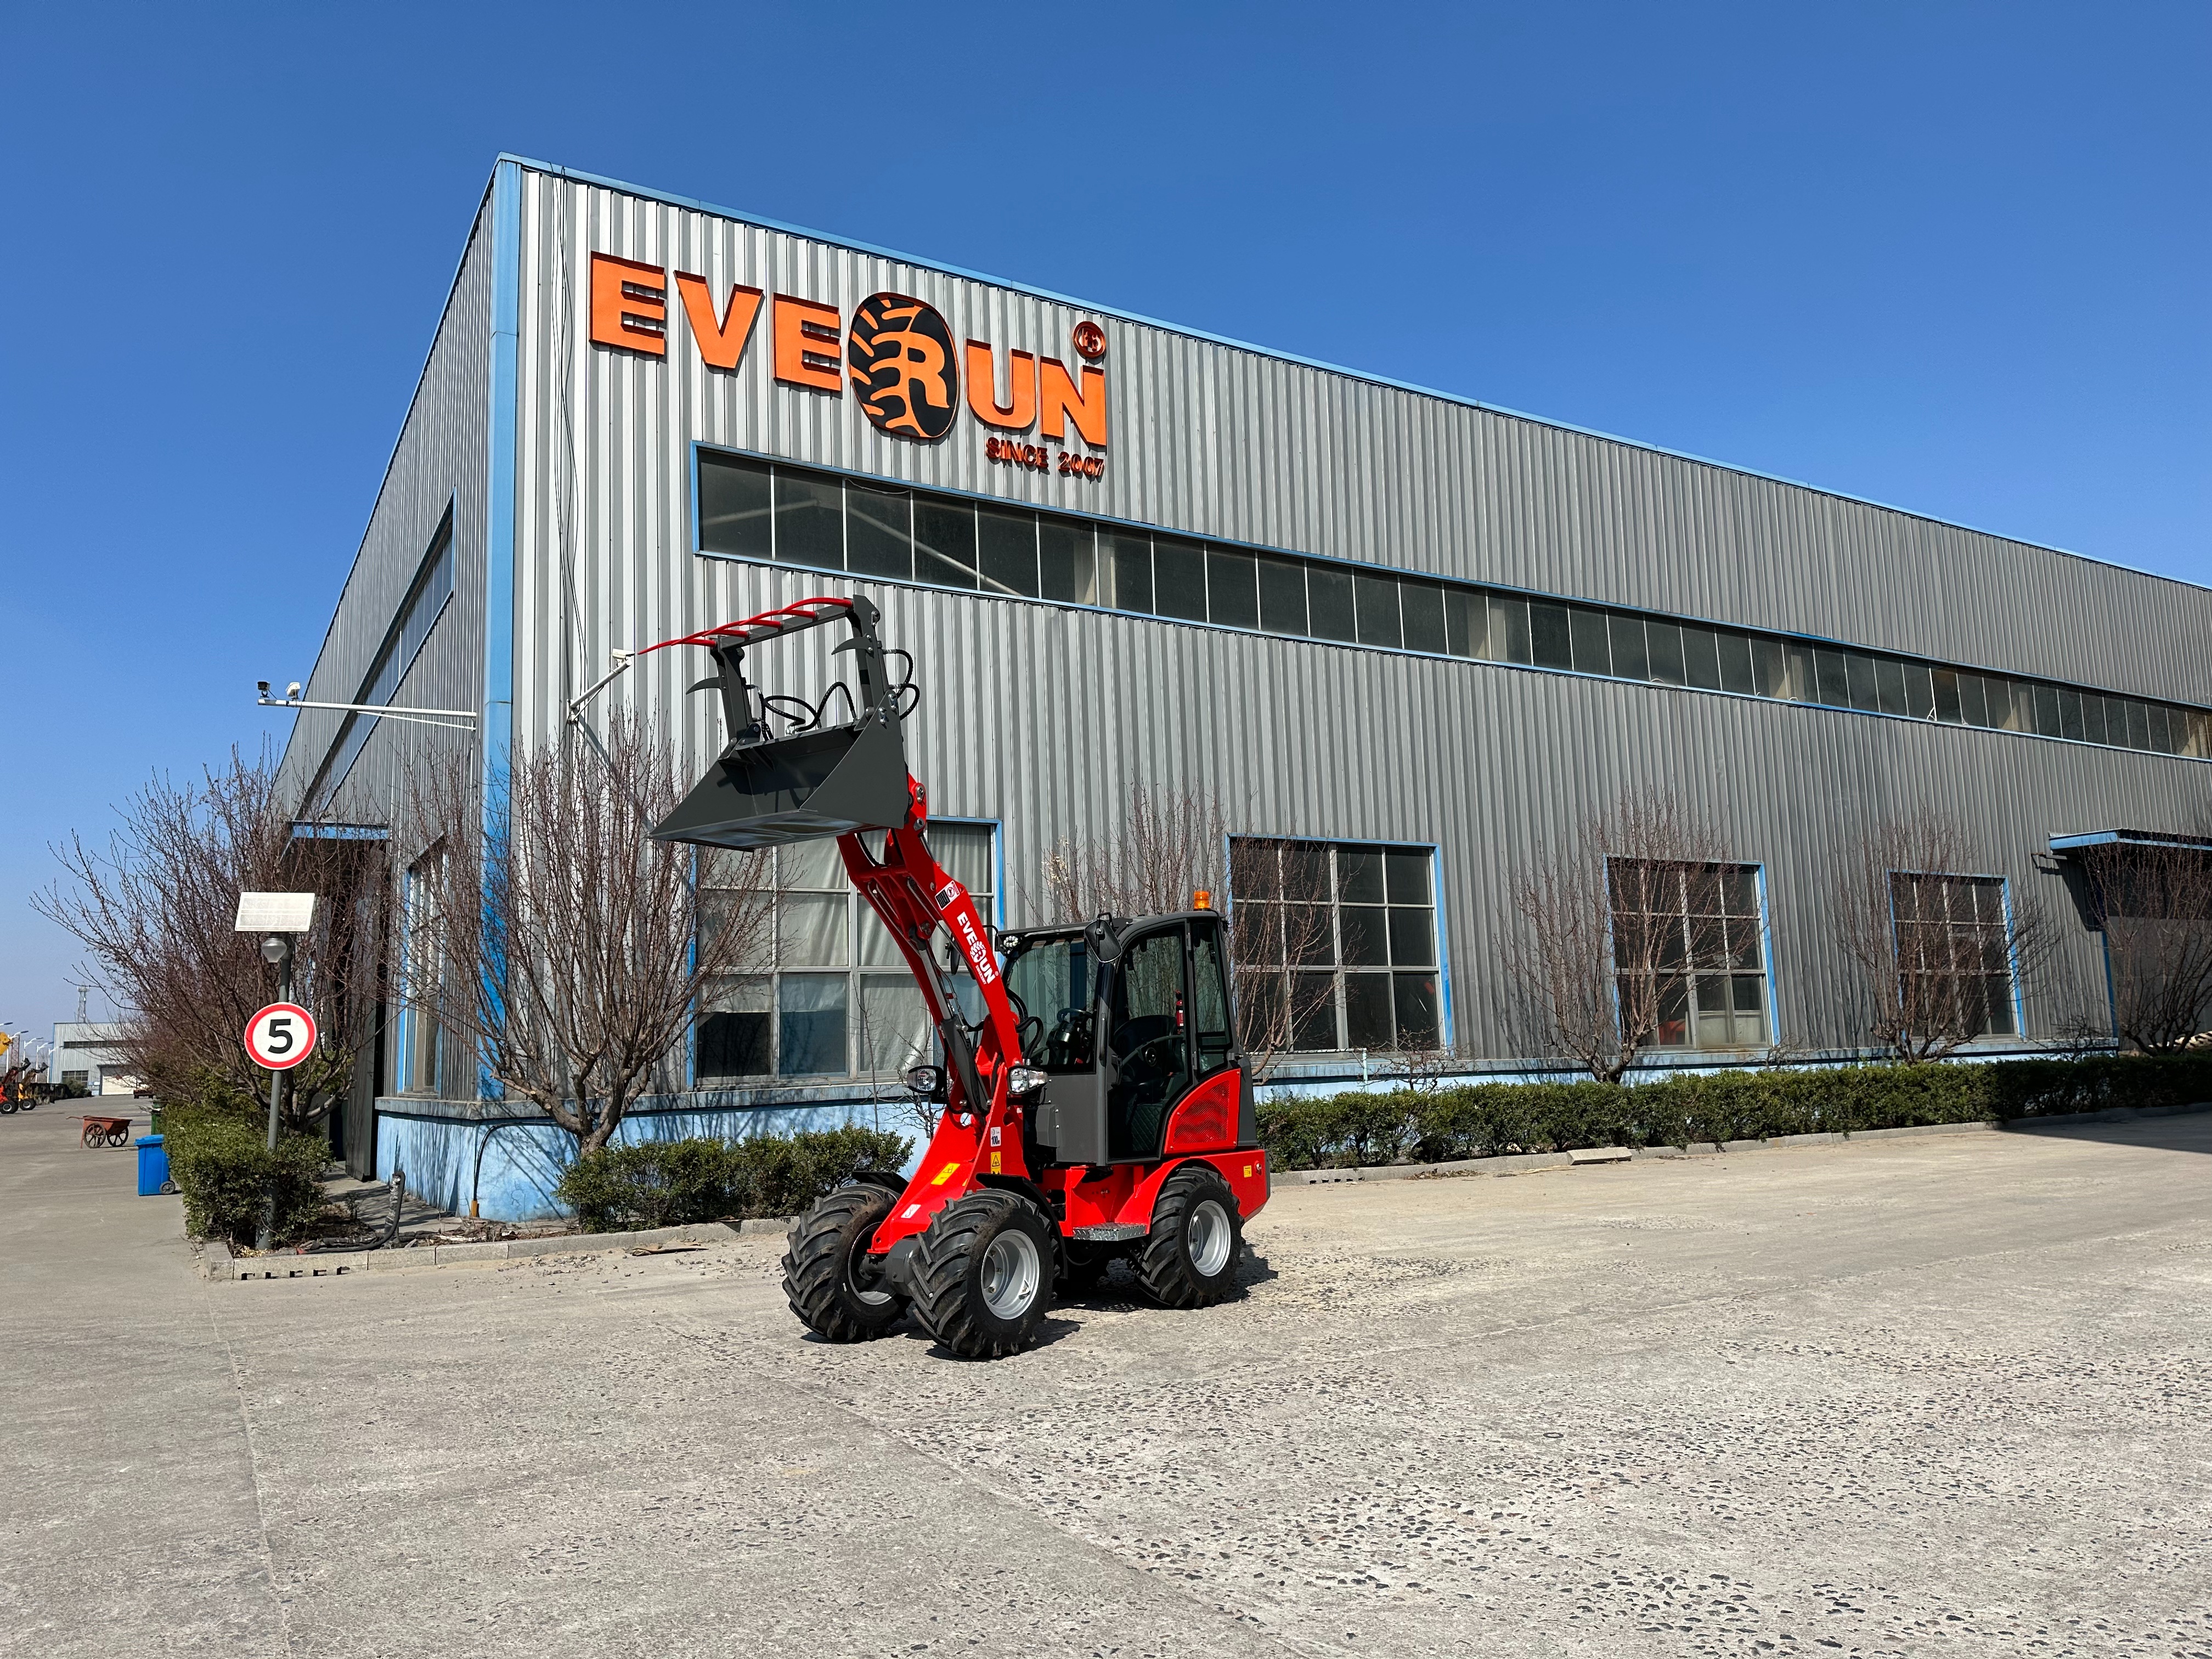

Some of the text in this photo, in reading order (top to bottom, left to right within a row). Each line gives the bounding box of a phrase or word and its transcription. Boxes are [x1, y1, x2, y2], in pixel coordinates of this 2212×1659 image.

[589, 251, 1107, 447] EVERUN
[986, 437, 1105, 476] SINCE 2007
[956, 911, 996, 984] EVERUN
[268, 1019, 293, 1054] 5
